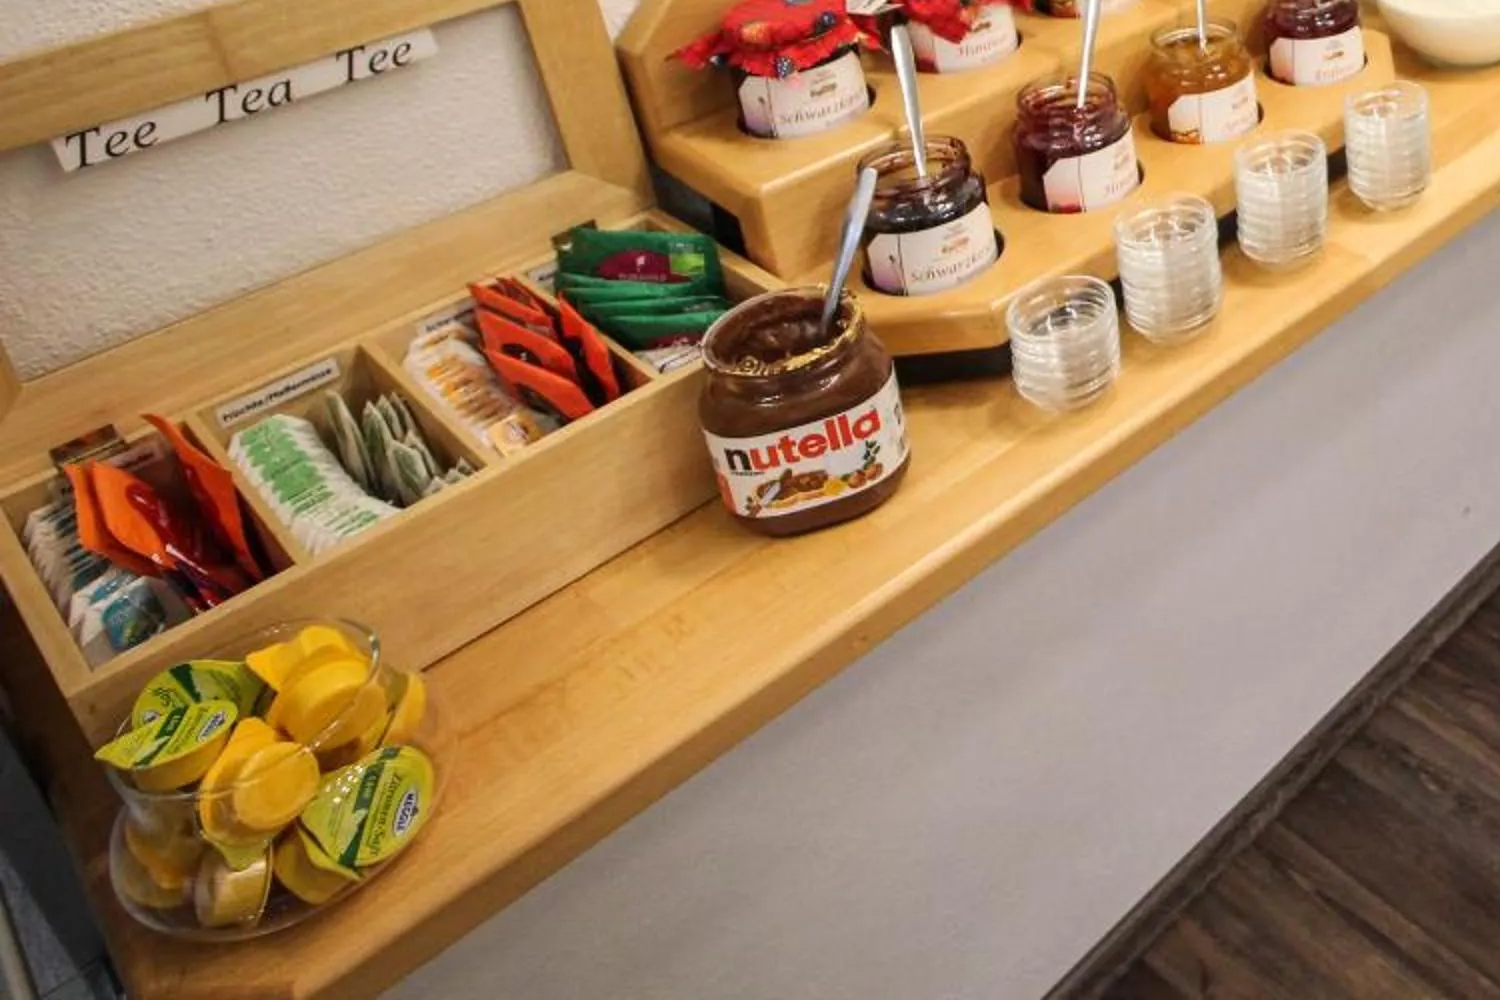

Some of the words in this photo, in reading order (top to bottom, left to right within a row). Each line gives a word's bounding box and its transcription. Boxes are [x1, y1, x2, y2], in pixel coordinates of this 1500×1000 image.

[65, 121, 160, 169] Tee
[205, 78, 293, 125] Tea
[335, 41, 412, 83] Tee
[723, 408, 881, 471] nutella
